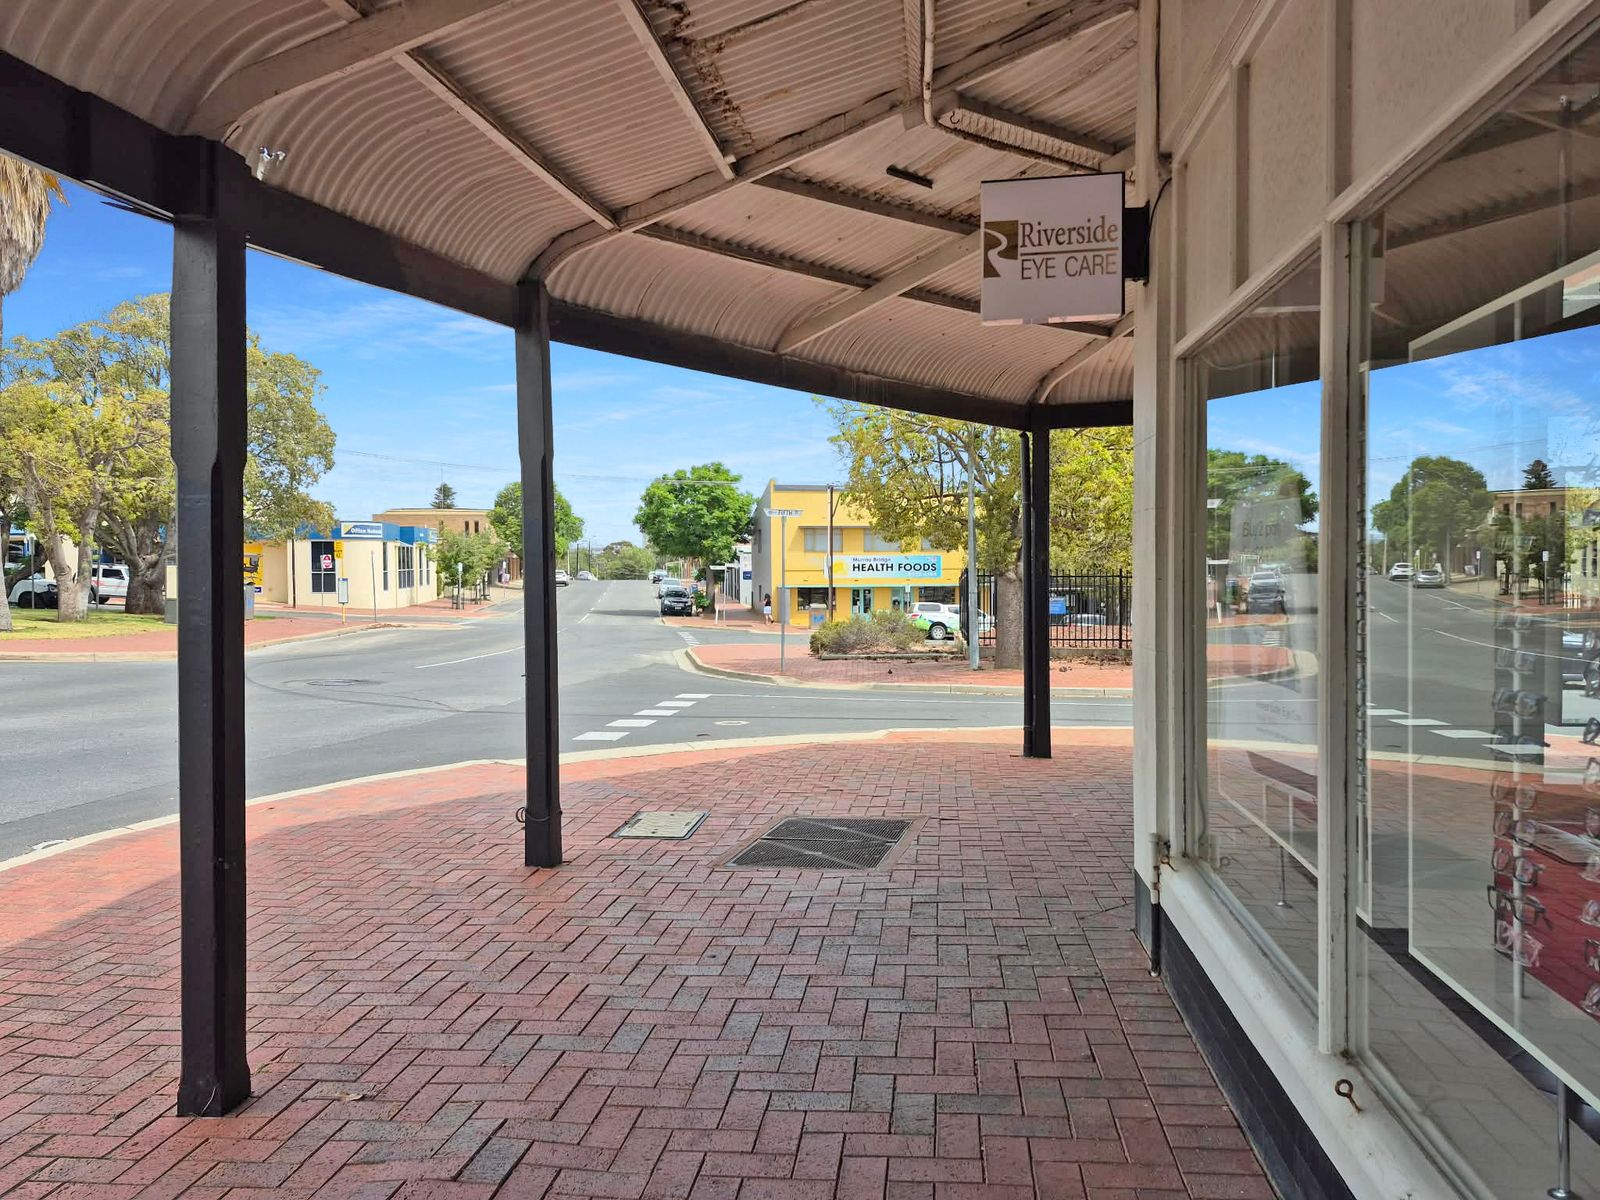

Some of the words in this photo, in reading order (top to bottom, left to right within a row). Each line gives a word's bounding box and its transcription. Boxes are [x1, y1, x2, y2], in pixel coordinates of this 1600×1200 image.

[1020, 215, 1119, 248] Riverside
[1021, 257, 1056, 280] EYE
[1065, 253, 1118, 277] CARE
[852, 563, 894, 572] HEALTH
[898, 563, 937, 572] FOODS
